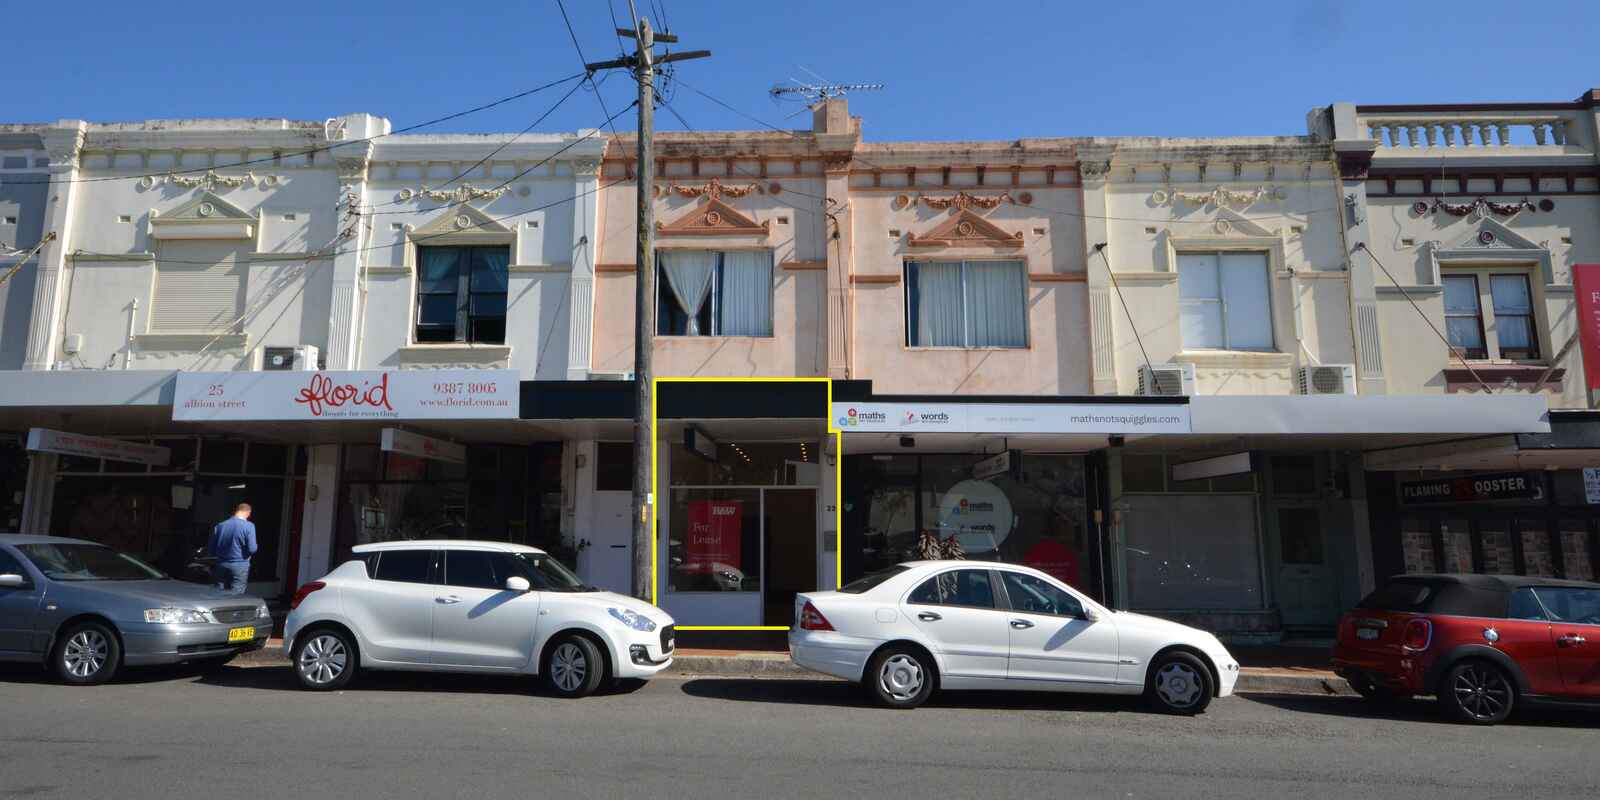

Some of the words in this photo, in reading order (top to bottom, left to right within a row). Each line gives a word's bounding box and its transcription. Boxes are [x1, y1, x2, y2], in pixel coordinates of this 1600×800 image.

[208, 384, 224, 396] 25
[433, 383, 463, 394] 9387
[467, 382, 497, 394] 8005
[294, 372, 393, 416] florid
[184, 399, 216, 408] albion
[218, 400, 247, 408] street
[418, 398, 509, 408] www.florid.com.au
[858, 411, 887, 420] maths
[920, 411, 950, 420] words
[1071, 412, 1181, 425] mathsnotsquiggles.com
[1403, 484, 1451, 498] FLAMING
[693, 522, 712, 533] For
[693, 535, 721, 545] Lease
